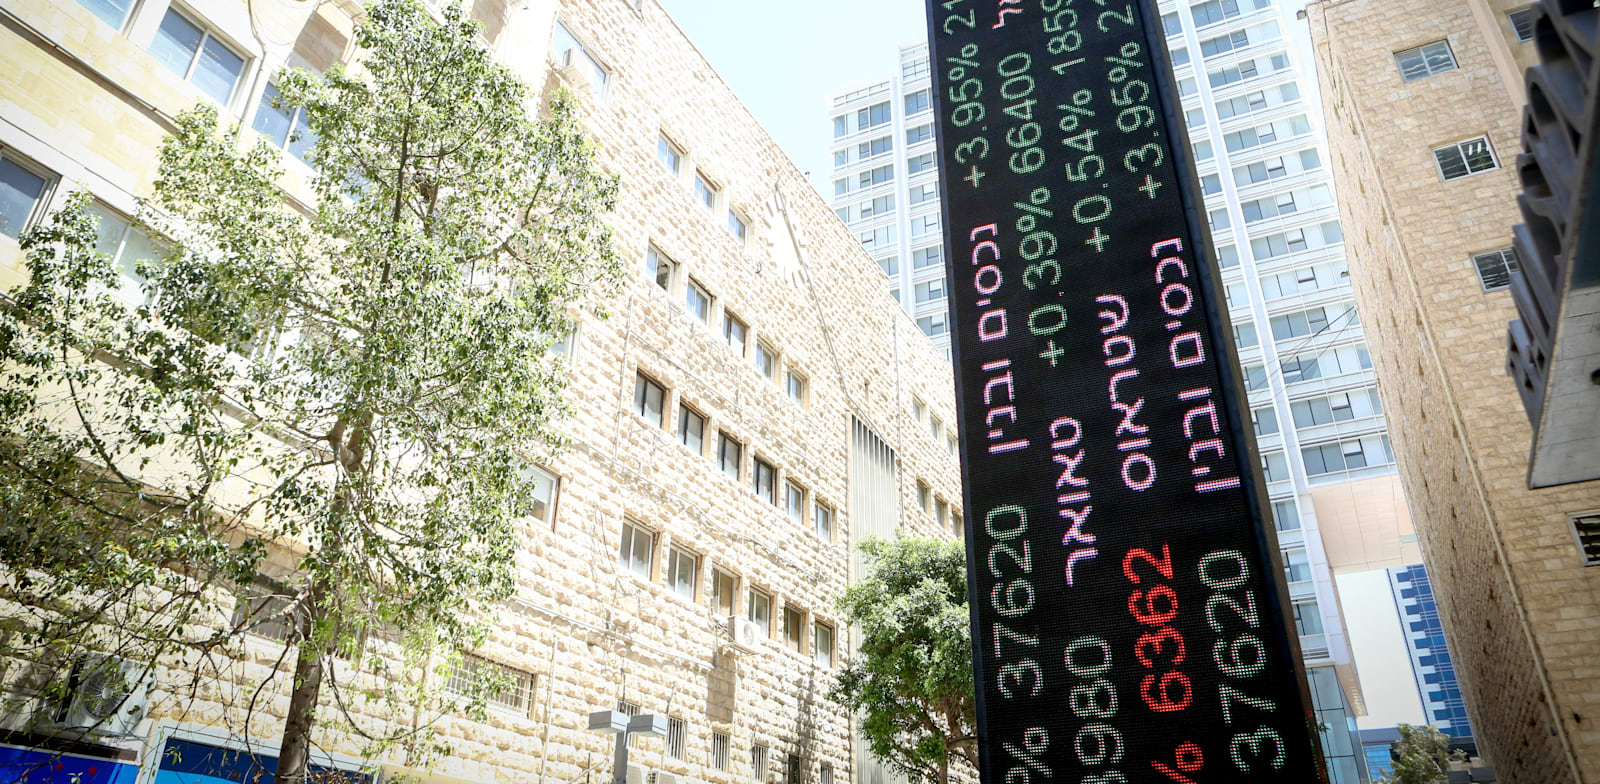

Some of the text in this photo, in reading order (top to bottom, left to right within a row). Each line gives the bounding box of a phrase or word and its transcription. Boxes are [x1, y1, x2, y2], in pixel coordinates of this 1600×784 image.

[946, 42, 990, 189] +3.95%
[1056, 88, 1113, 254] +0.54%
[1093, 0, 1164, 200] +3.95% 2
[996, 51, 1068, 369] +0.39% 66400
[969, 222, 1031, 455] נכסים ובנין
[1095, 293, 1158, 492] שטראוס
[1150, 236, 1241, 494] נכסים ובנין
[984, 503, 1044, 699] 37620
[1048, 416, 1099, 588] טאואר
[1121, 541, 1193, 713] 6362
[1197, 549, 1285, 773] 37620
